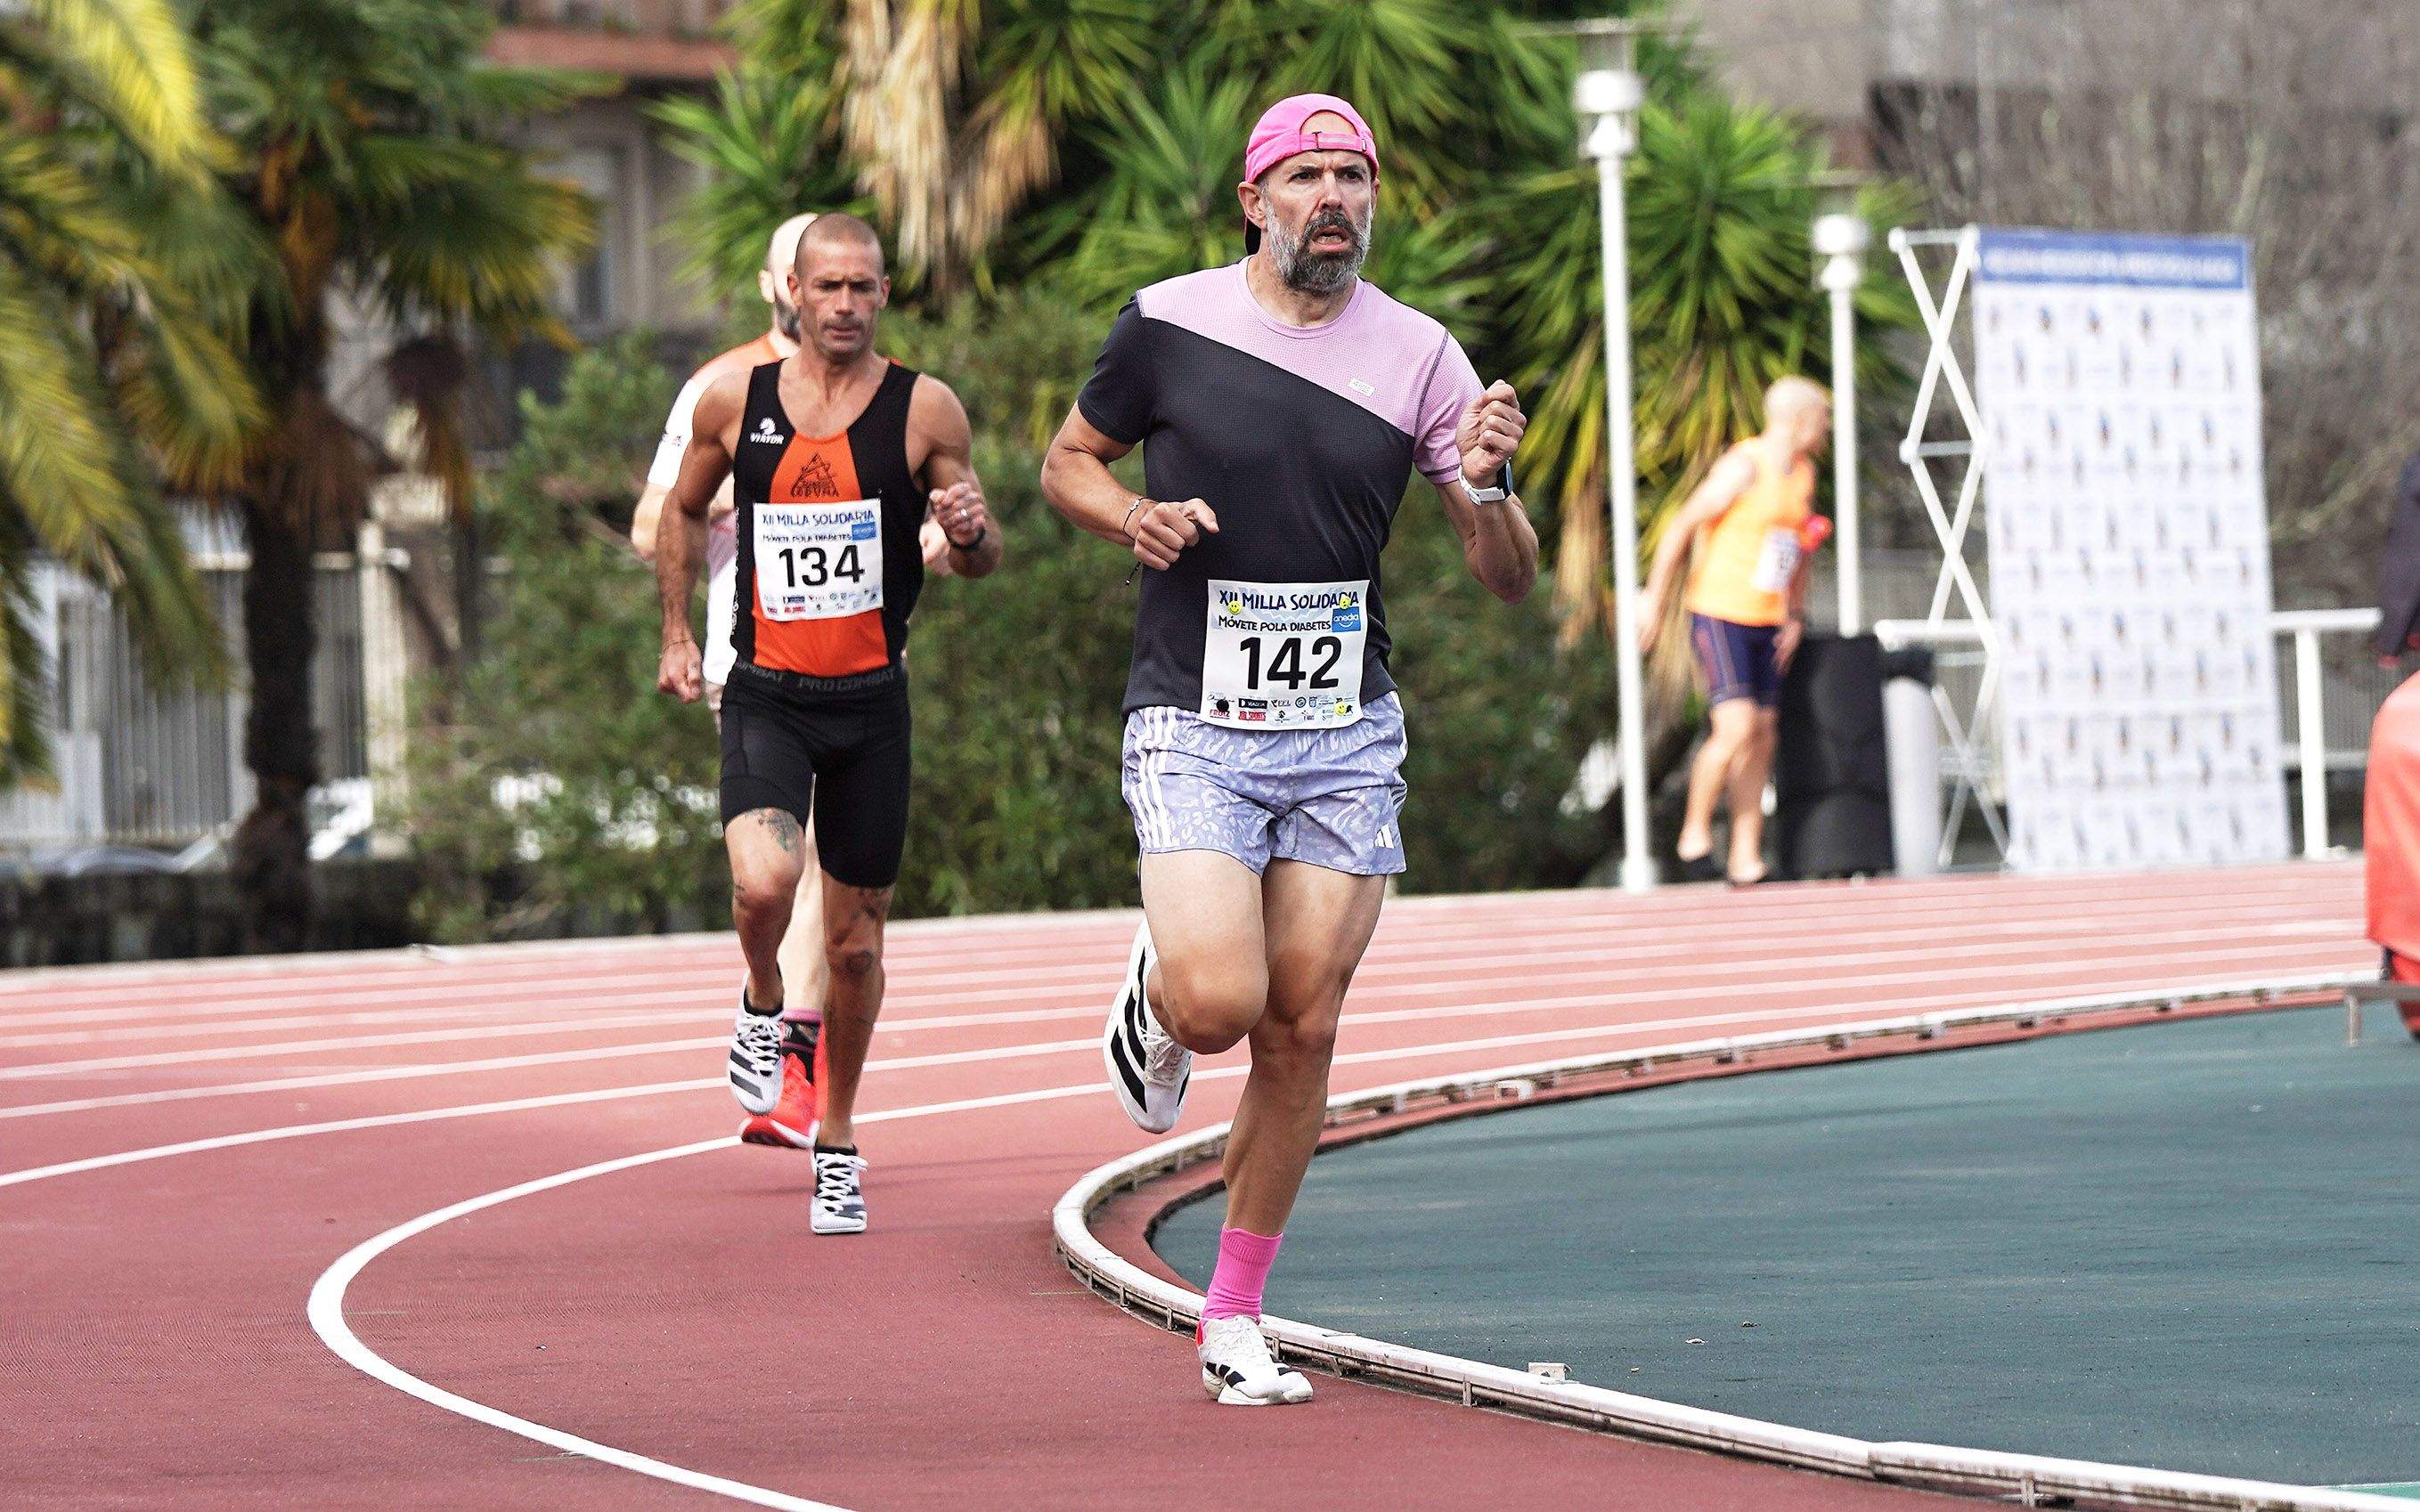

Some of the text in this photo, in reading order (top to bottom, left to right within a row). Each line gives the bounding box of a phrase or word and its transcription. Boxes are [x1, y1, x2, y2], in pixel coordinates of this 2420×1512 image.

[762, 510, 874, 526] XII MILLA SOLIDARIA
[778, 545, 865, 588] 134
[1219, 590, 1238, 606] XII
[1243, 593, 1286, 610] MILLA
[1218, 615, 1331, 631] MÓVETE POLA DIABETES
[1240, 636, 1342, 690] 142
